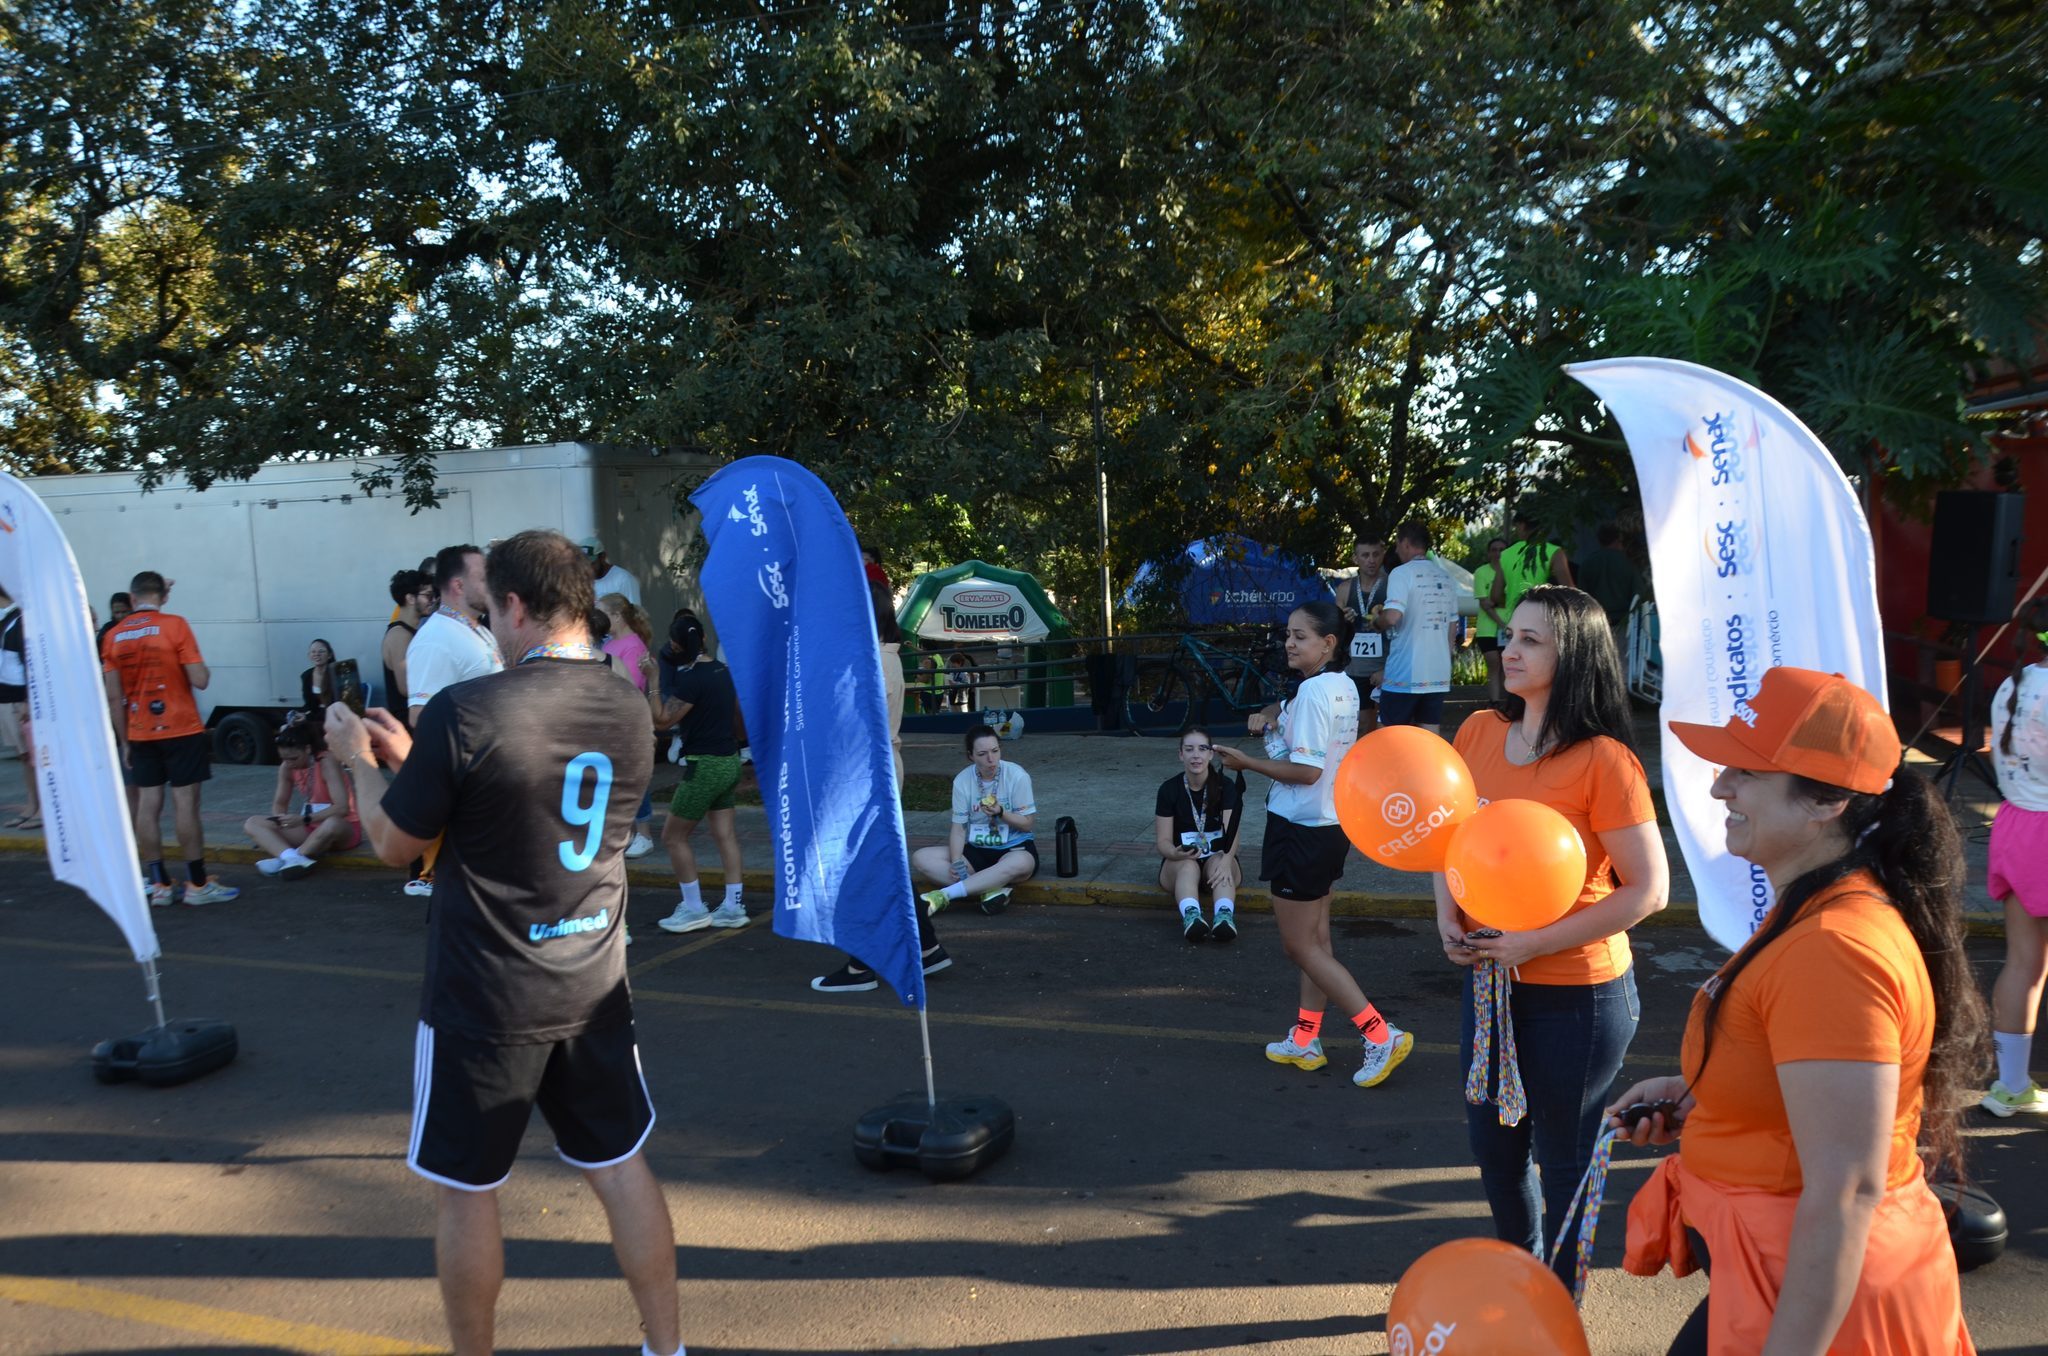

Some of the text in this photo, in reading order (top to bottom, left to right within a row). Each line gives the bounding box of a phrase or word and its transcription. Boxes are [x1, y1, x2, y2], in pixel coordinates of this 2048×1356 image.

[959, 594, 1005, 603] ERVA-MATE
[1355, 642, 1376, 655] 721
[1766, 609, 1783, 667] omércio
[794, 681, 806, 731] Sistema
[559, 752, 613, 872] 9
[1377, 804, 1455, 858] CRESOL
[779, 794, 802, 911] Fecomércio
[529, 908, 609, 941] Unimed
